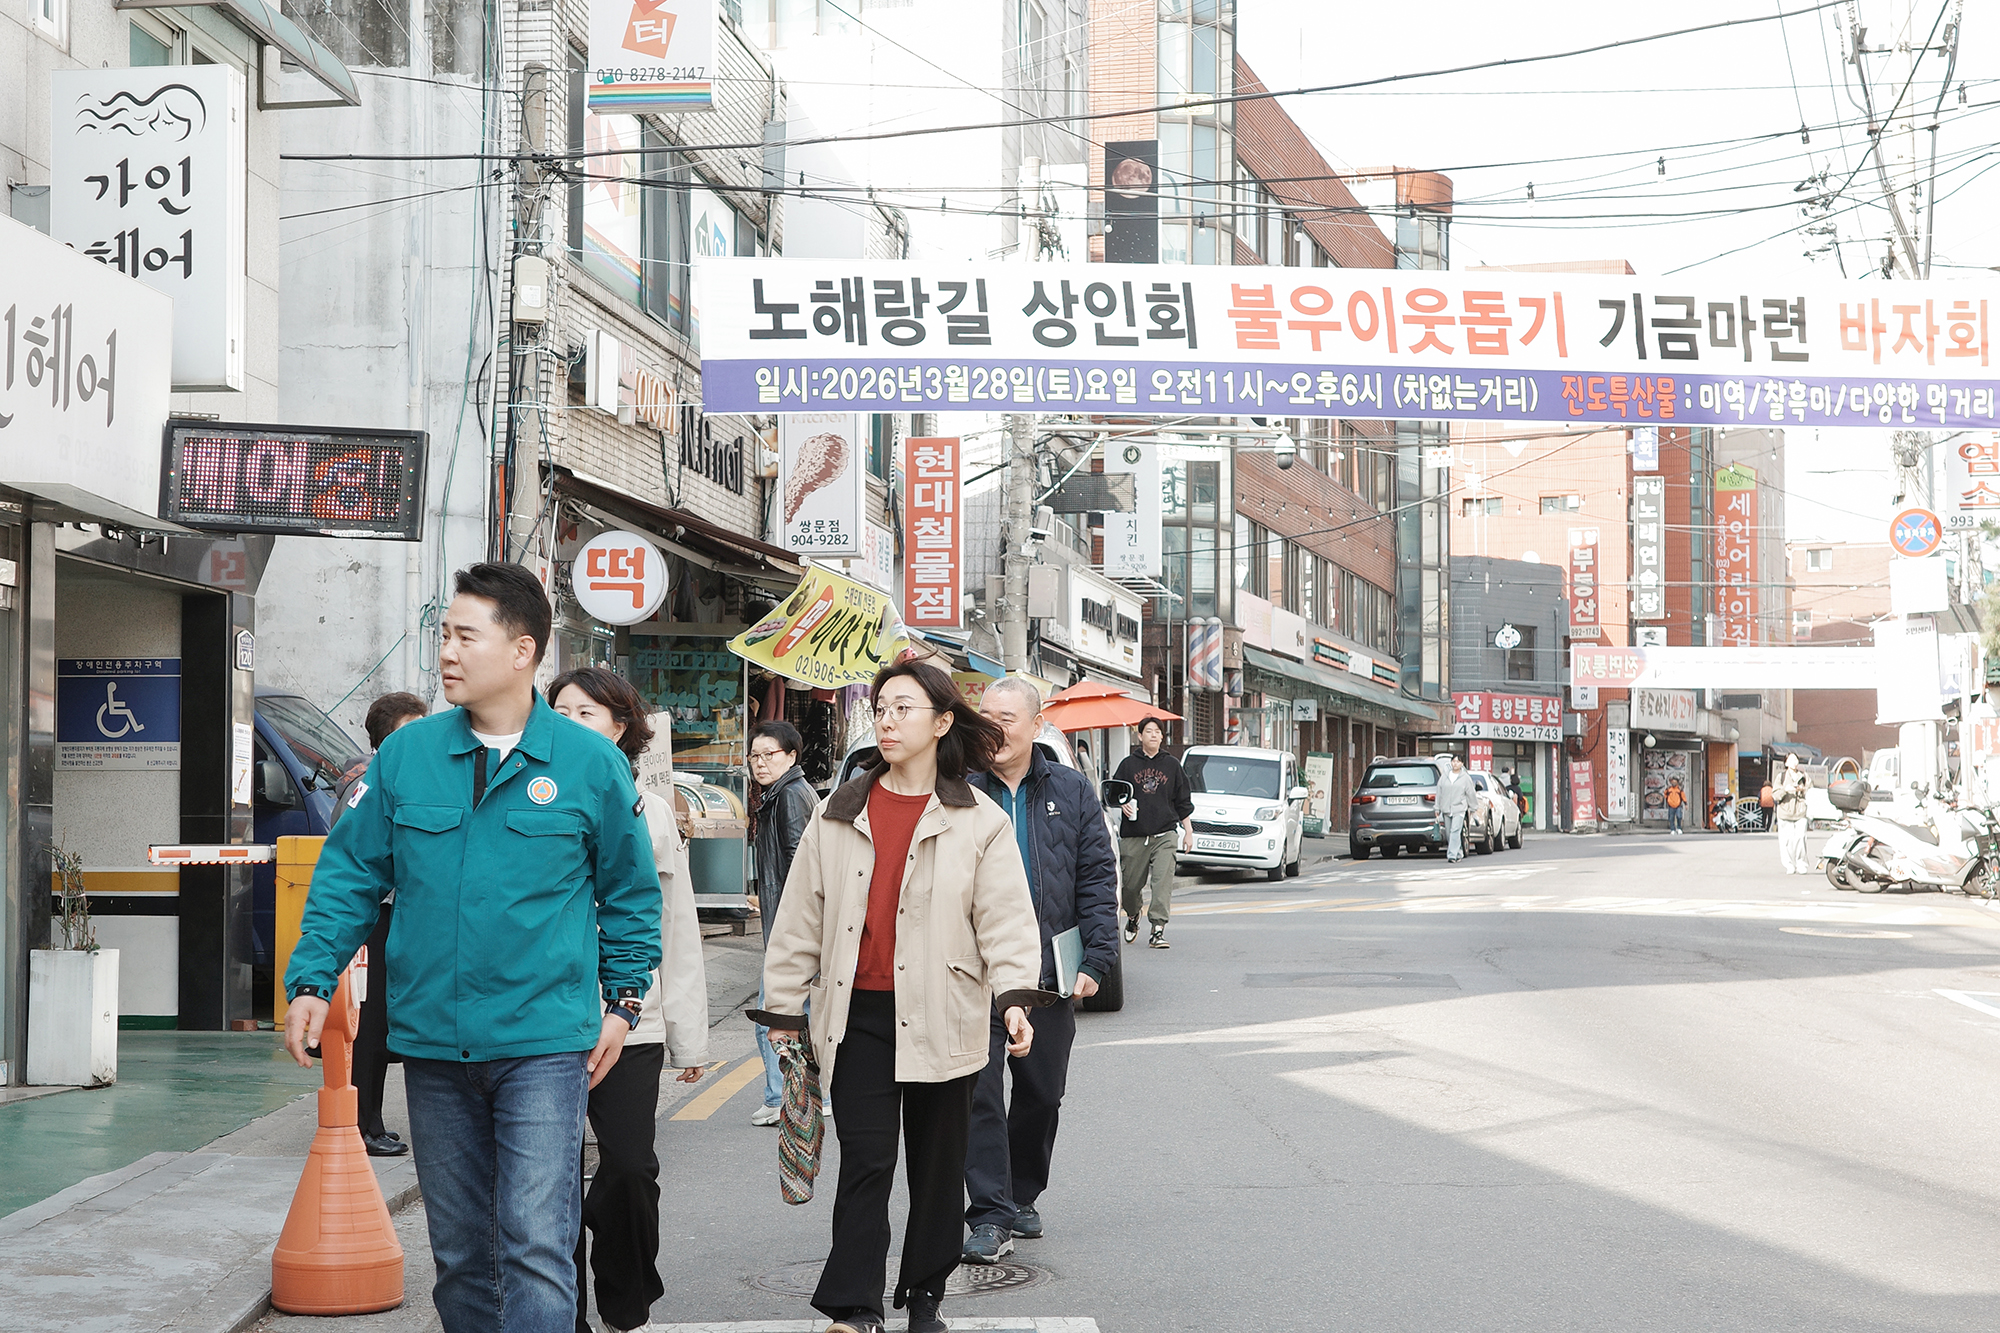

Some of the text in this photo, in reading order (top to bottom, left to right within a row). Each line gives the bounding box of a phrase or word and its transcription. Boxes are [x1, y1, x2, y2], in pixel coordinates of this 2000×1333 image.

[632, 18, 668, 45] 터
[84, 156, 192, 215] 가인
[749, 276, 1989, 366] 노해랑길 상인회 불우이웃돕기 기금마련 바자회
[754, 364, 1138, 405] 일시:2026년3월28일(토)요일
[1149, 367, 1384, 409] 오전11시~오후6시
[1393, 372, 1539, 413] (차없는거리)
[1561, 375, 1676, 419] 진도특산물
[1699, 379, 1920, 424] 미역/찰흑미/다양한
[1929, 383, 1994, 424] 먹거리
[791, 534, 850, 546] 904-9282
[799, 519, 841, 533] 쌍문점
[910, 445, 955, 620] 현대철물점
[586, 546, 646, 610] 떡
[1572, 548, 1598, 623] 부동산
[1727, 492, 1751, 647] 세인어린이집
[1571, 626, 1600, 637] 992-1743
